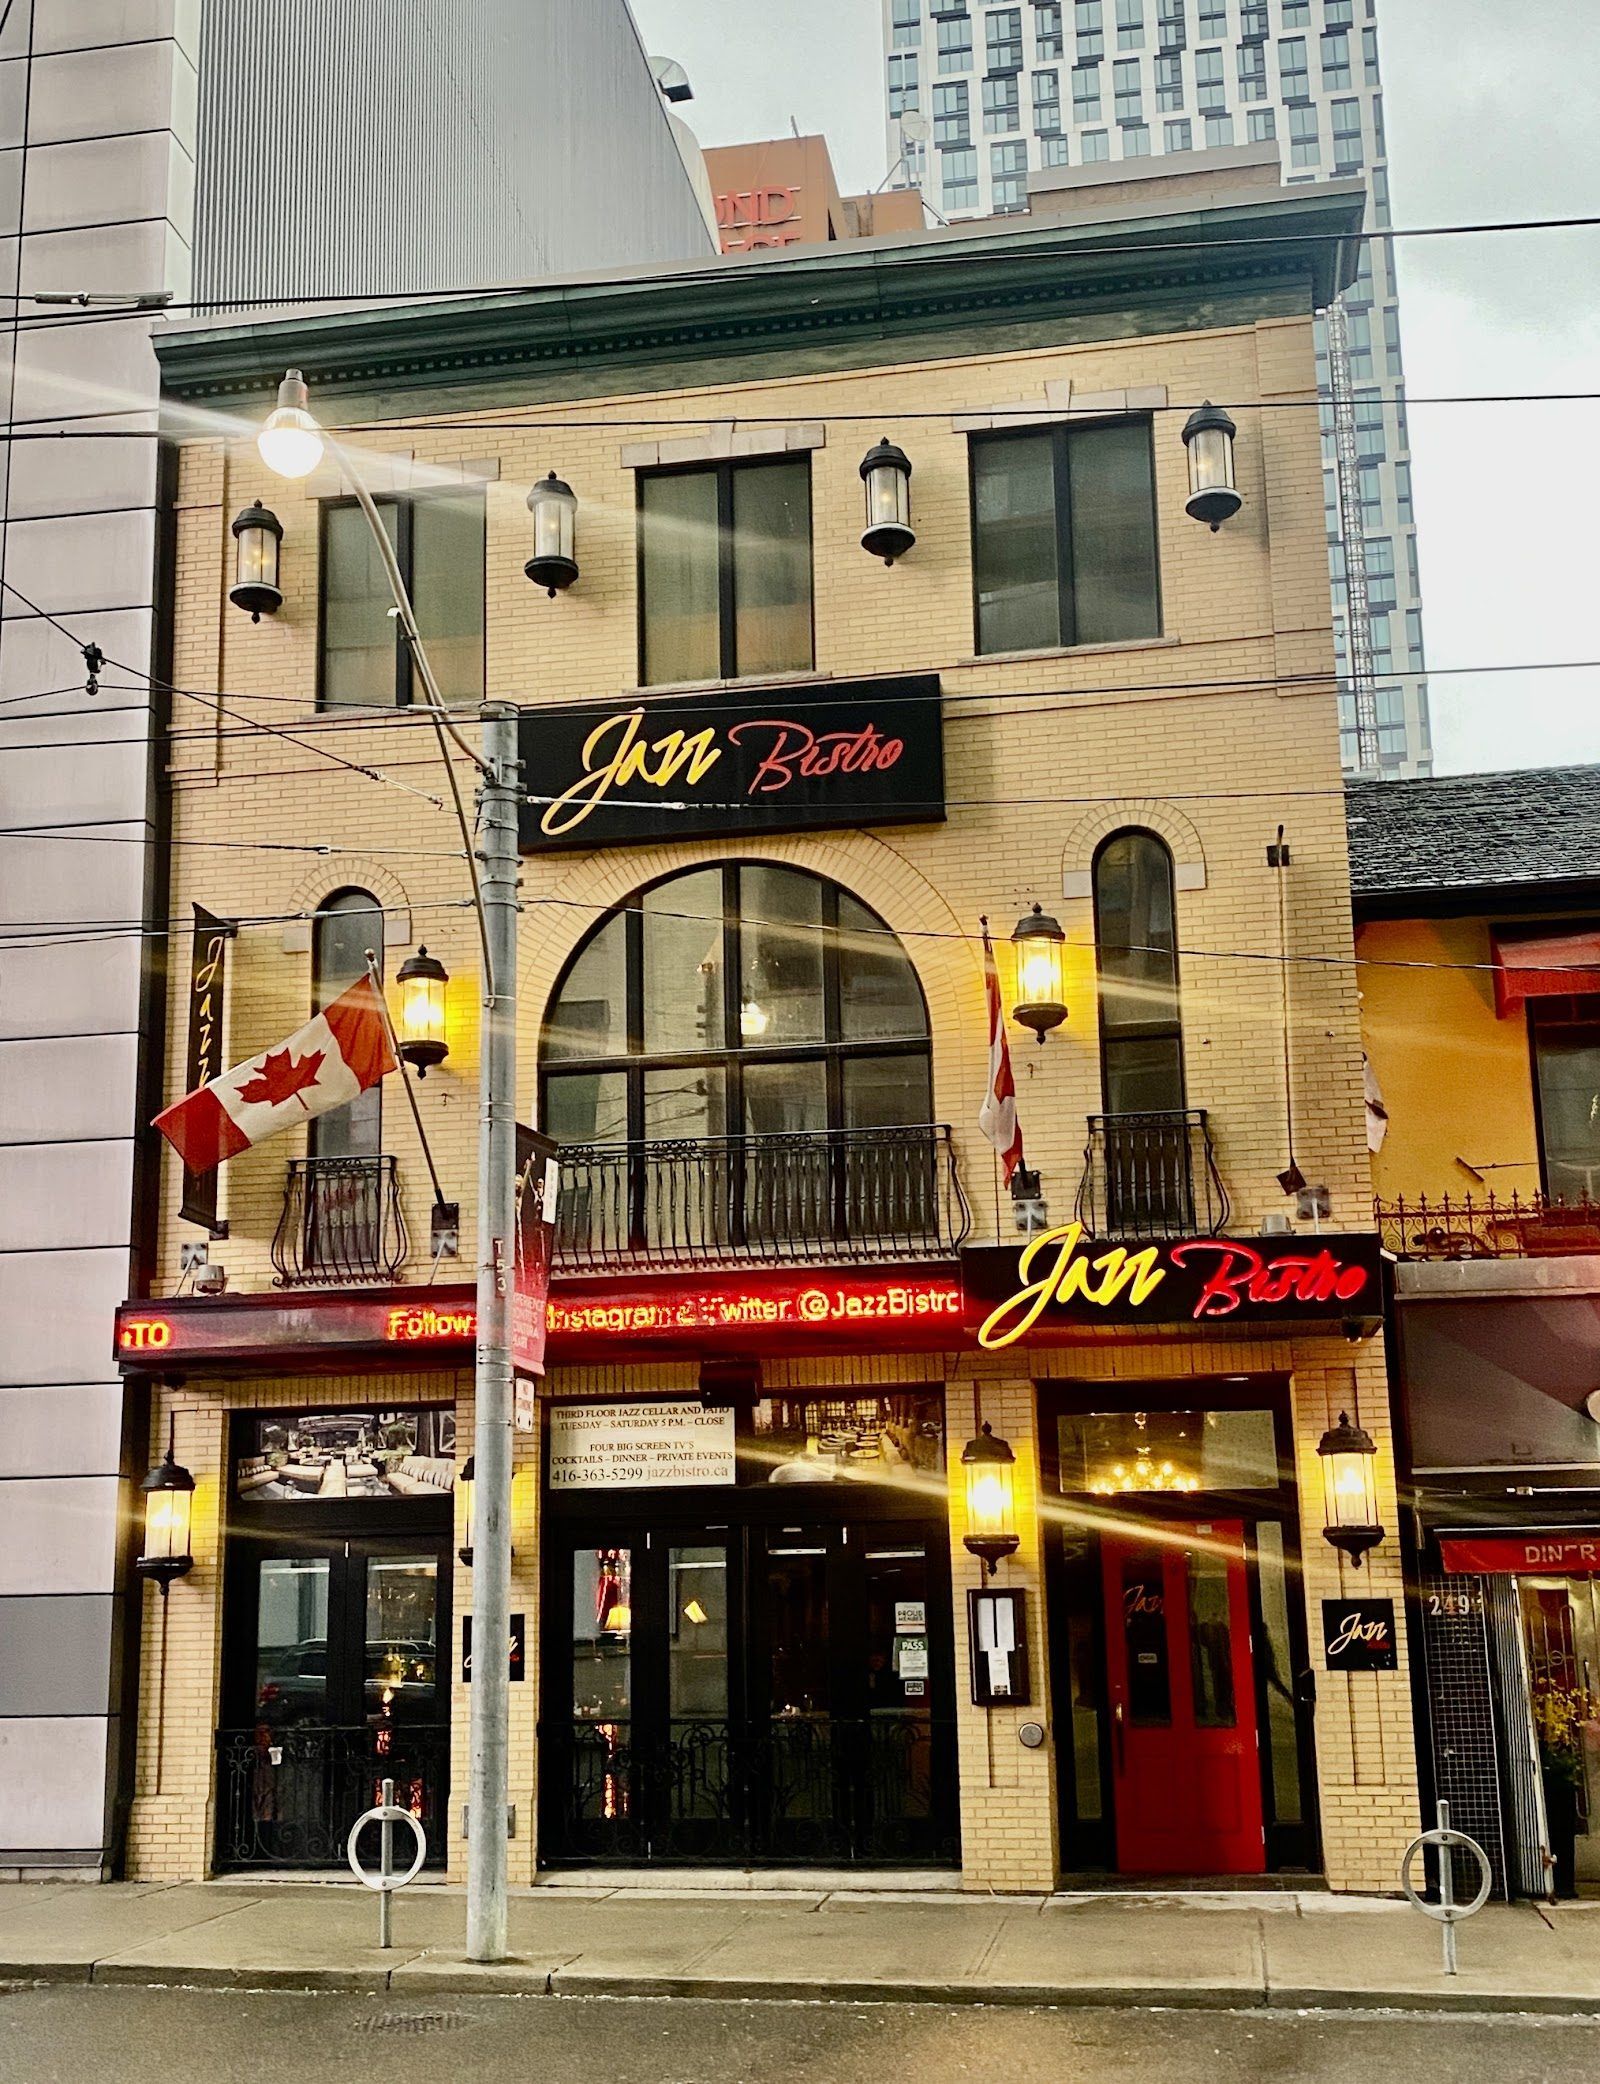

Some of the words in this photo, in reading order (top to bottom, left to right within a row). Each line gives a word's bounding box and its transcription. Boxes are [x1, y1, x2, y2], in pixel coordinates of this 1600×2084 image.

[540, 706, 722, 836] Jazz
[728, 720, 905, 796] Bistro
[977, 1220, 1166, 1349] Jazz
[1170, 1240, 1368, 1318] Bistro
[556, 1410, 583, 1419] THIRD
[586, 1409, 616, 1417] FLOOR
[619, 1408, 640, 1417] JAZZ
[643, 1407, 679, 1415] CELLAR
[681, 1406, 700, 1415] AND
[560, 1421, 602, 1431] TUESDAY
[610, 1419, 659, 1428] SATURDAY
[661, 1419, 666, 1427] 5
[668, 1418, 686, 1427] P.M.
[694, 1417, 725, 1425] CLOSE
[590, 1443, 614, 1452] FOUR
[617, 1443, 633, 1451] BIG
[635, 1441, 671, 1450] SCREEN
[552, 1455, 603, 1465] COCKTAILS
[612, 1454, 648, 1463] DINNER
[657, 1452, 694, 1461] PRIVATE
[696, 1451, 733, 1460] EVENTS
[552, 1468, 643, 1482] 416-363-5299
[647, 1465, 728, 1480] jazzbistro.ca
[1327, 1612, 1388, 1655] Jazz
[901, 1641, 924, 1650] PASS
